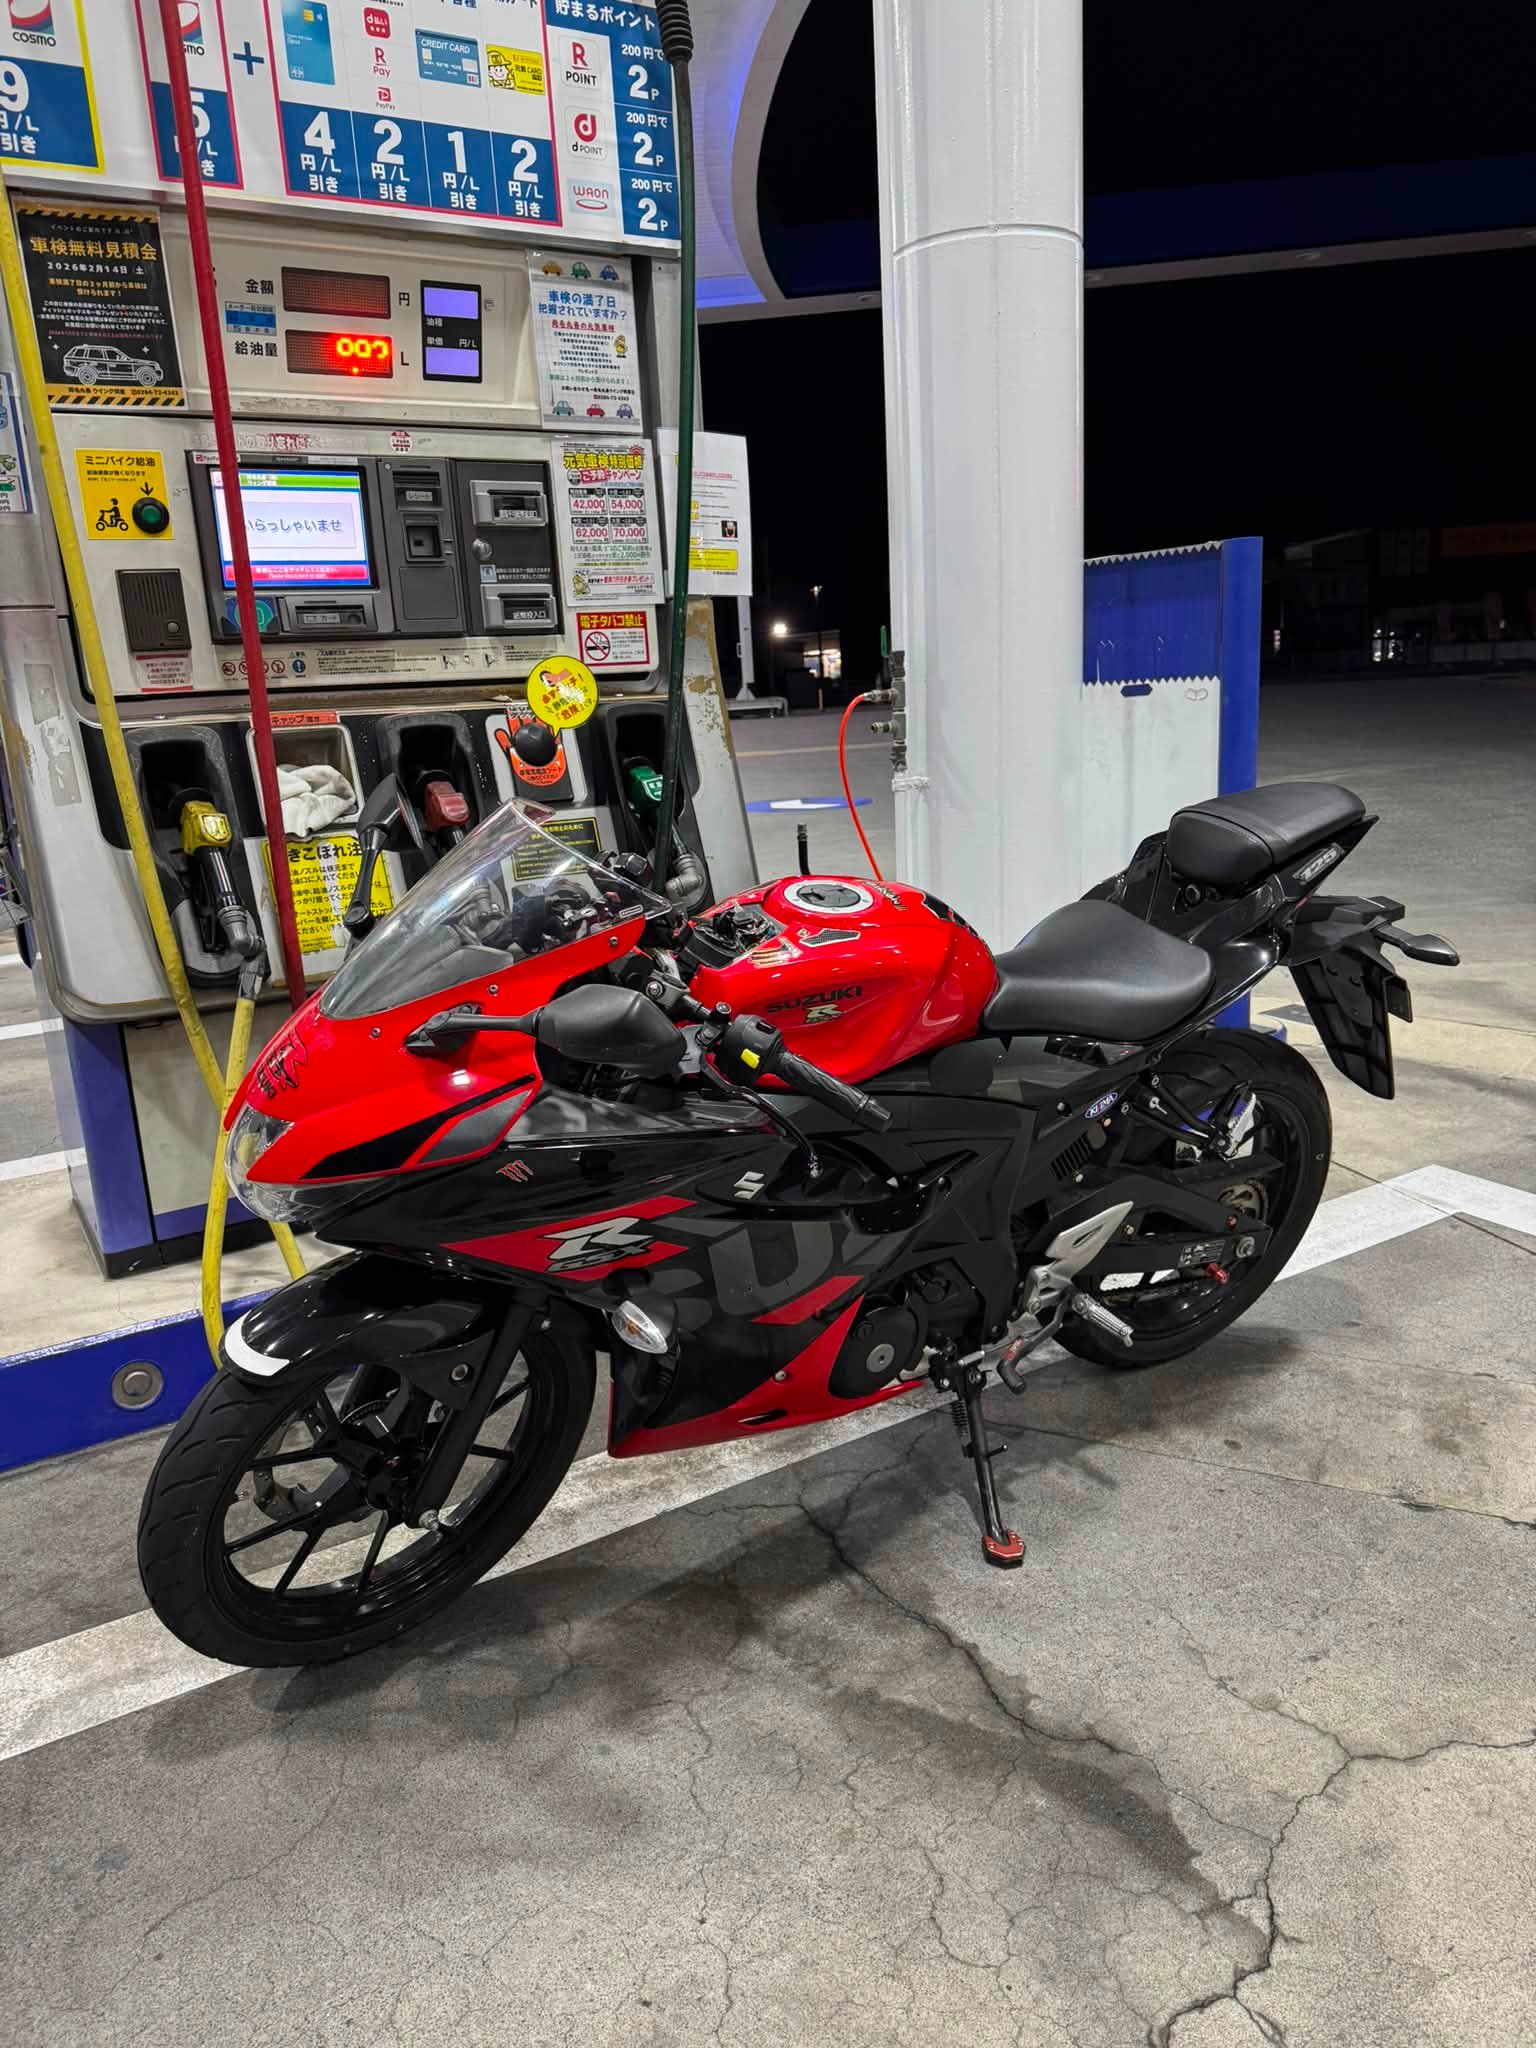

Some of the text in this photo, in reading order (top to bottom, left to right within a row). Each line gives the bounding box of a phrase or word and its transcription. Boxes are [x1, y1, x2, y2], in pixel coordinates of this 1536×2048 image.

[556, 1, 655, 31] 貯まるポイント
[12, 31, 57, 47] COSMO
[421, 39, 471, 54] CREDIT CARD
[566, 71, 597, 87] POINT
[625, 112, 668, 129] 200円で
[304, 111, 336, 156] 4
[373, 119, 405, 166] 2
[447, 130, 467, 173] 1
[511, 139, 540, 184] 2
[308, 175, 339, 194] 引き
[378, 184, 408, 202] 引き
[573, 184, 609, 200] WAON
[631, 178, 673, 194] 200円で
[449, 192, 478, 211] 引き
[515, 200, 541, 218] 引き
[31, 237, 157, 261] 車検無料見積会
[47, 262, 127, 275] 2026年2月14日
[245, 279, 274, 295] 金額
[399, 292, 410, 307] 円
[549, 290, 616, 308] 車検の満了日
[234, 340, 278, 358] 給油量
[401, 352, 409, 366] L
[85, 455, 156, 467] ミニバイク給油
[580, 613, 644, 629] 電子タバコ禁止
[1299, 847, 1338, 882] 125
[767, 985, 862, 1014] SUZUKI
